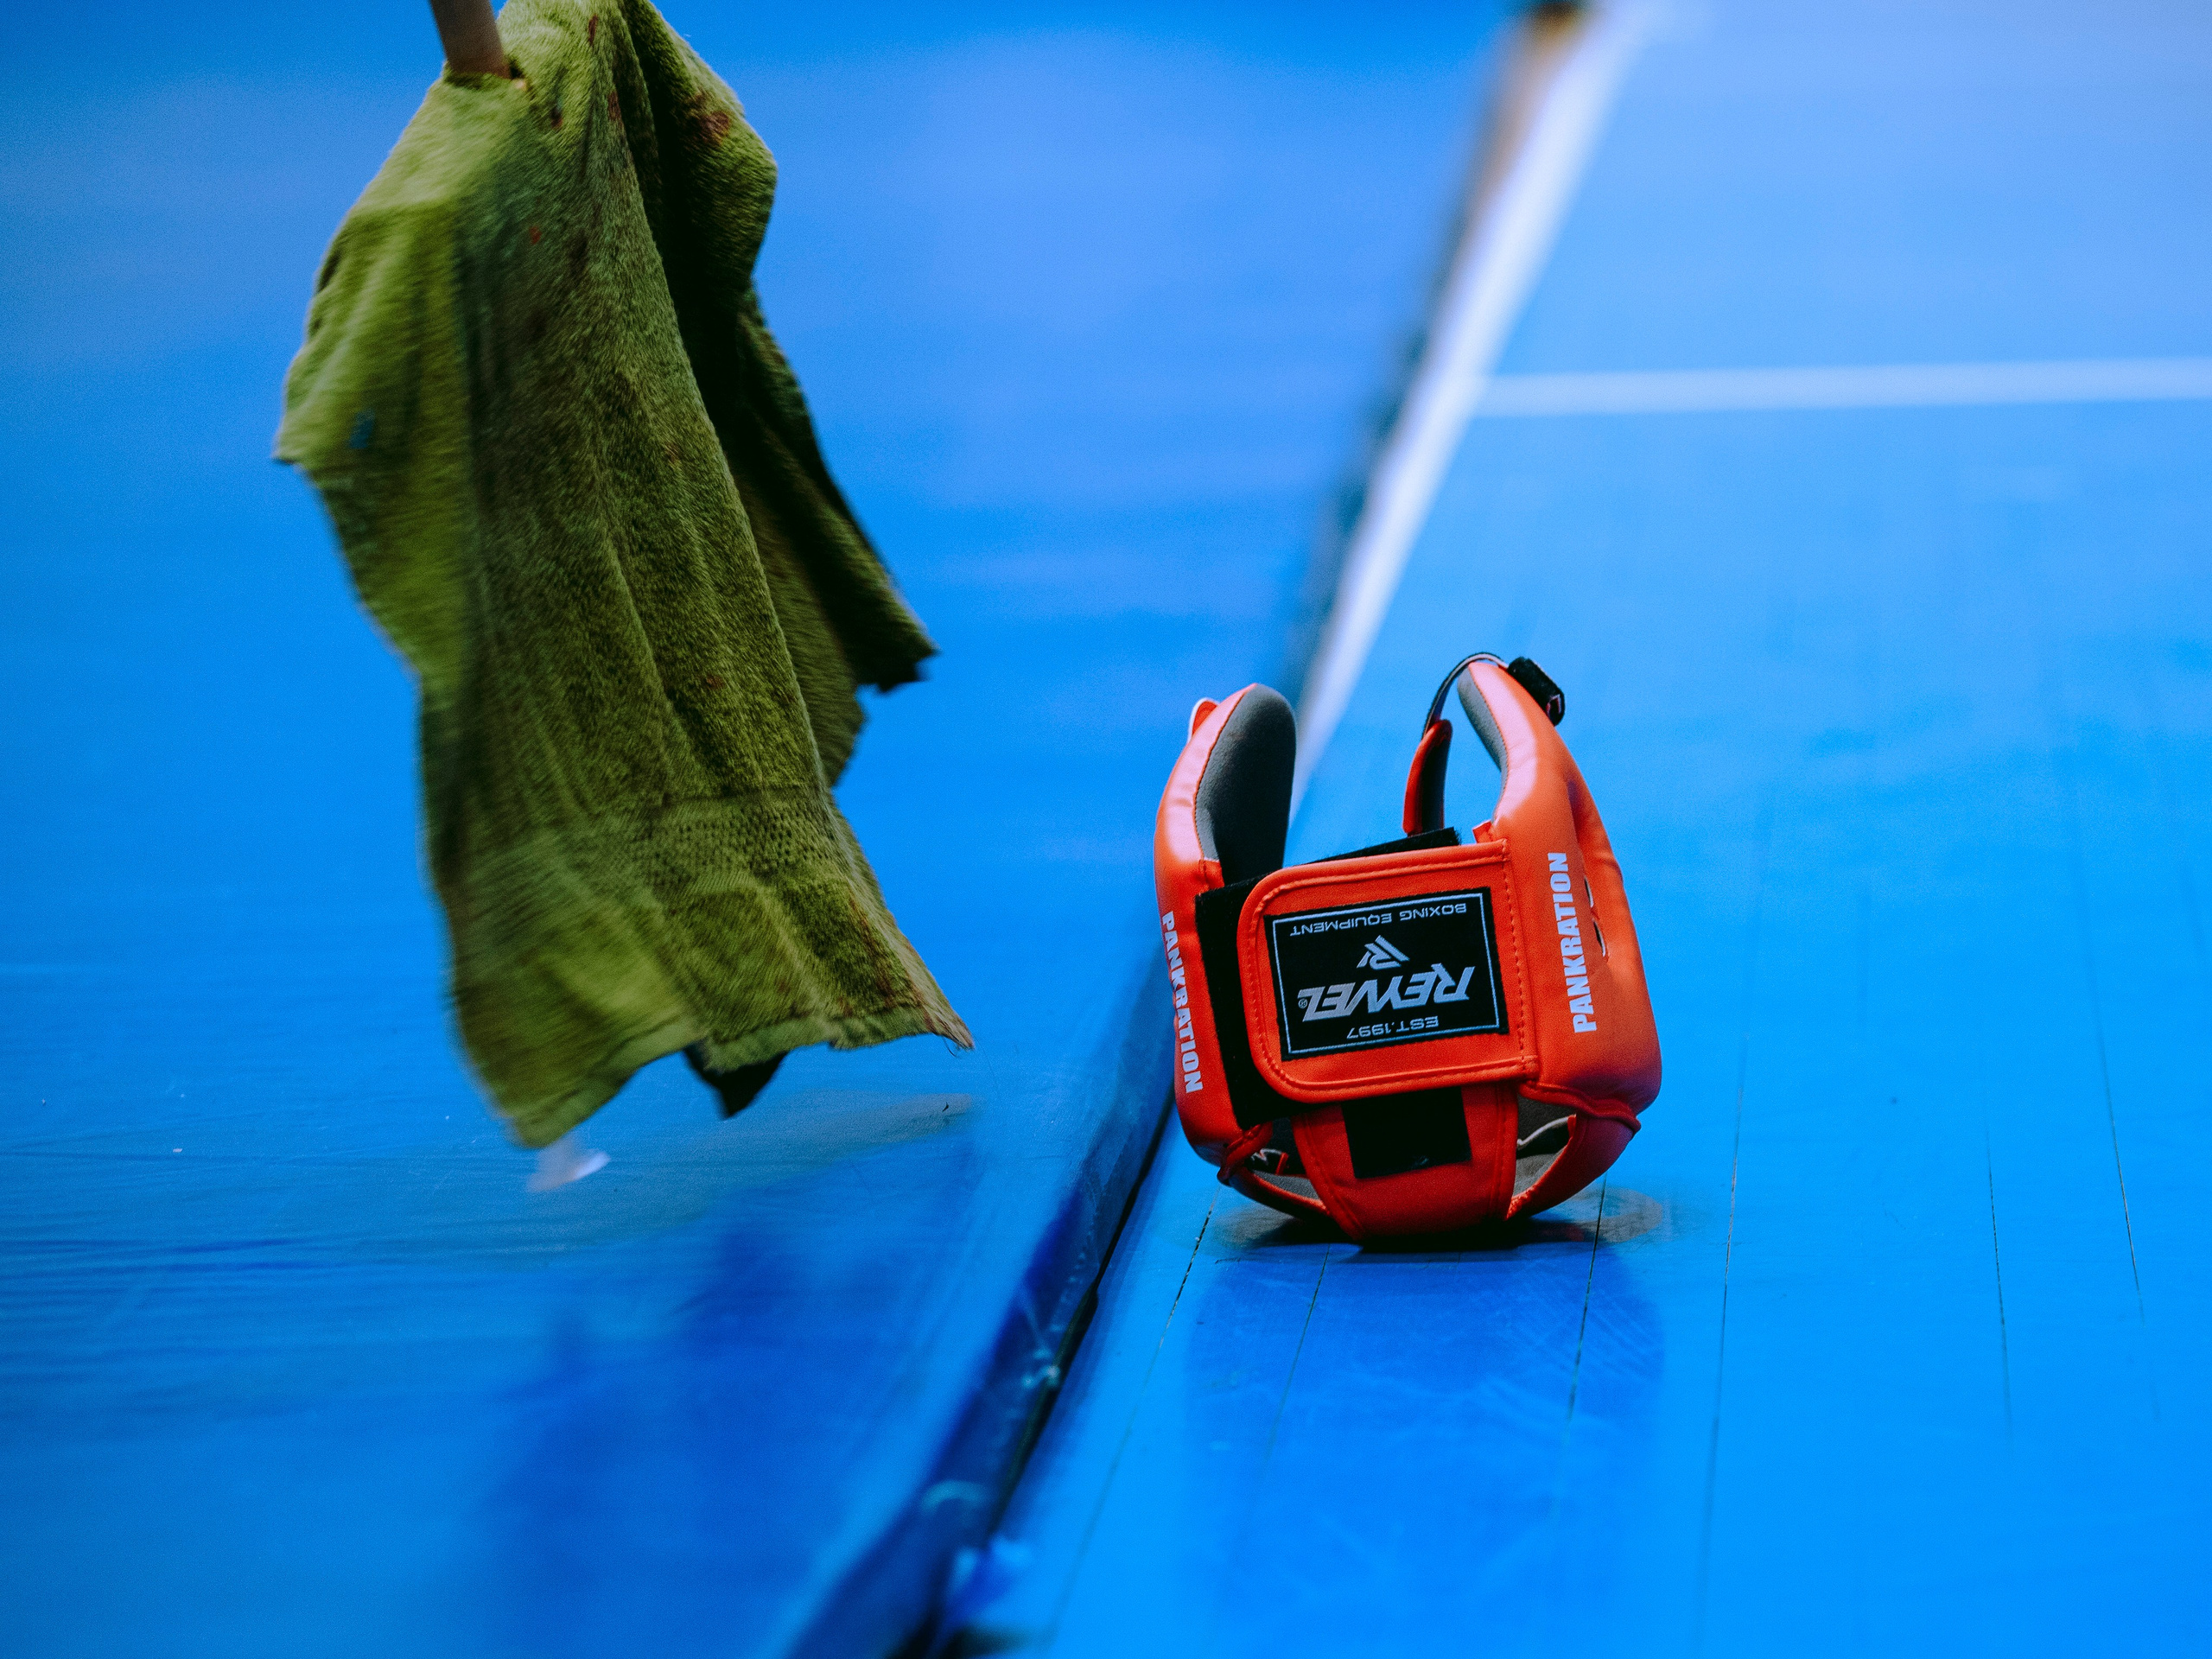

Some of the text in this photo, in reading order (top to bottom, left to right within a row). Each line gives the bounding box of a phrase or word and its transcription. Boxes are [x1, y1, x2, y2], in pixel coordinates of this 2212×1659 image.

[1290, 903, 1467, 937] BOXING EQUIPMENT
[1547, 852, 1598, 1033] PANKRATION
[1162, 911, 1204, 1094] PANKRATION
[1297, 963, 1476, 1022] REYVEL
[1347, 1015, 1440, 1039] EST.1997
